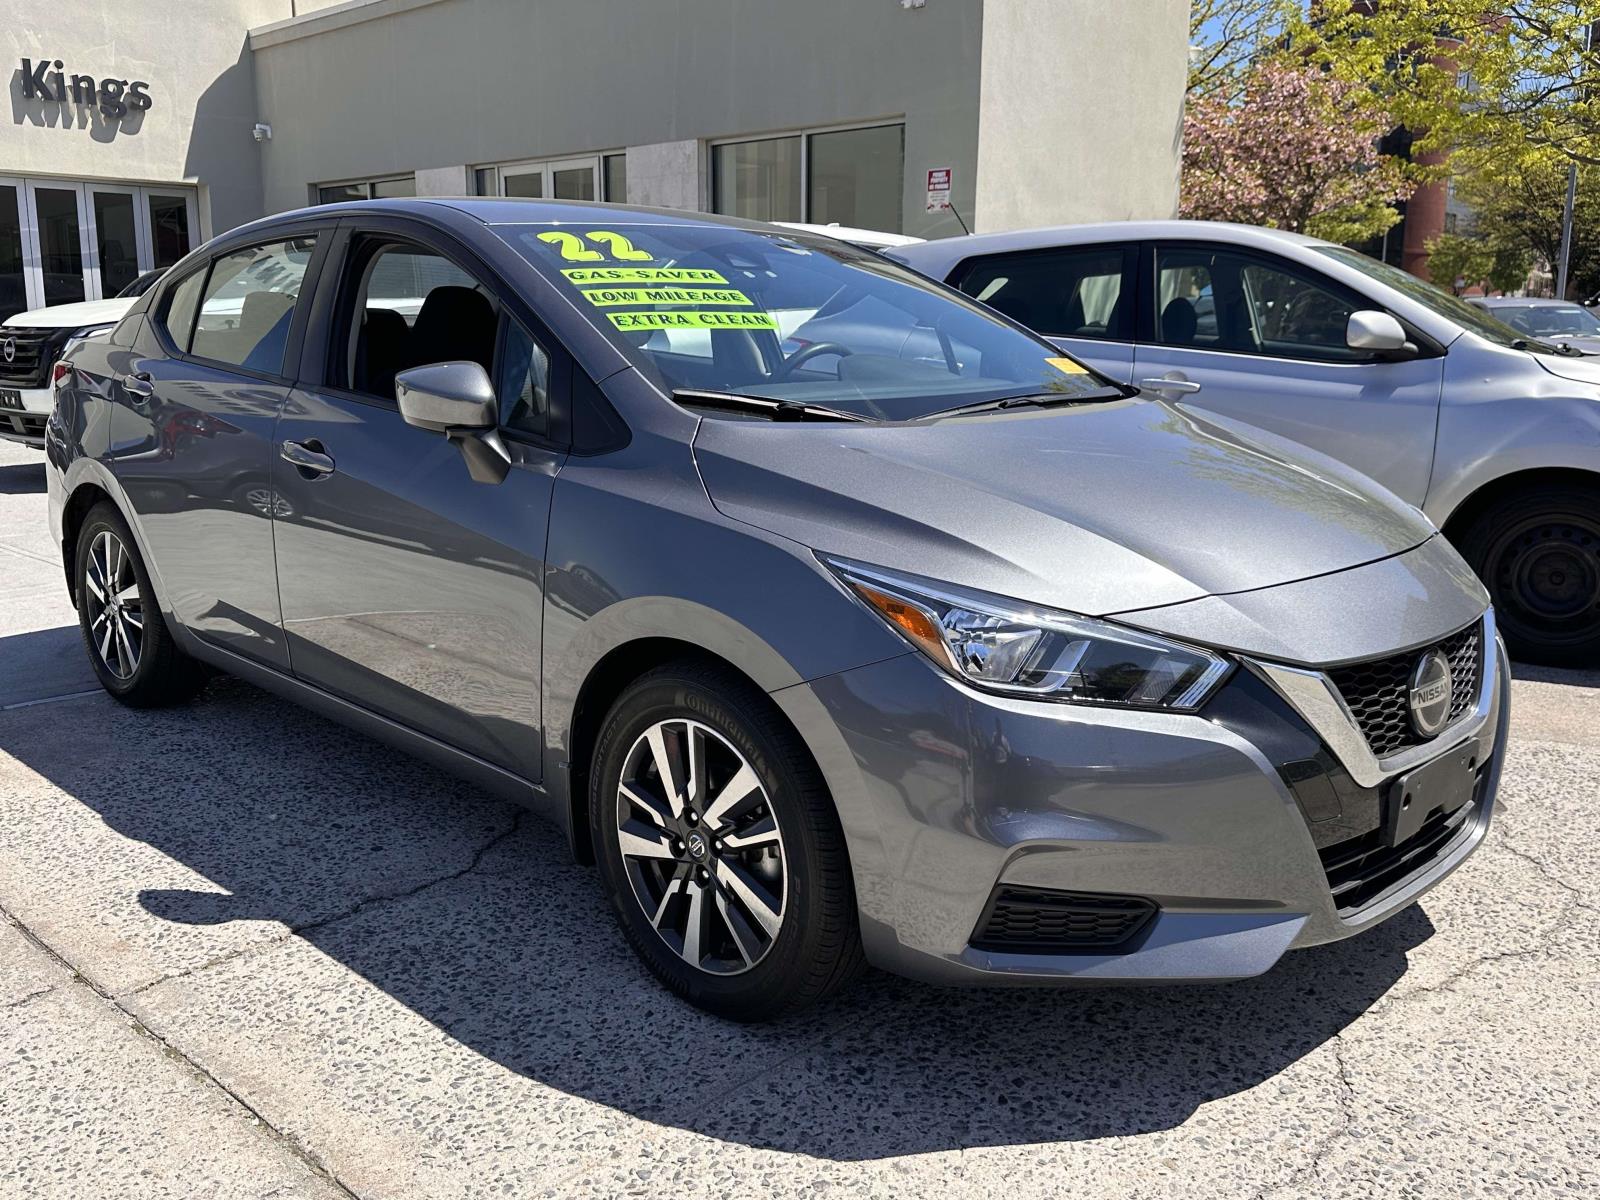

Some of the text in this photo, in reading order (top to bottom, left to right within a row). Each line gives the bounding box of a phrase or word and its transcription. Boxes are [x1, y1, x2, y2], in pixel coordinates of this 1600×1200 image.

[21, 58, 152, 118] Kings
[536, 231, 654, 261] 22
[567, 270, 718, 281] GAS-SAVER
[589, 291, 744, 302] LOW MILEAGE
[613, 313, 770, 326] EXTRA CLEAN
